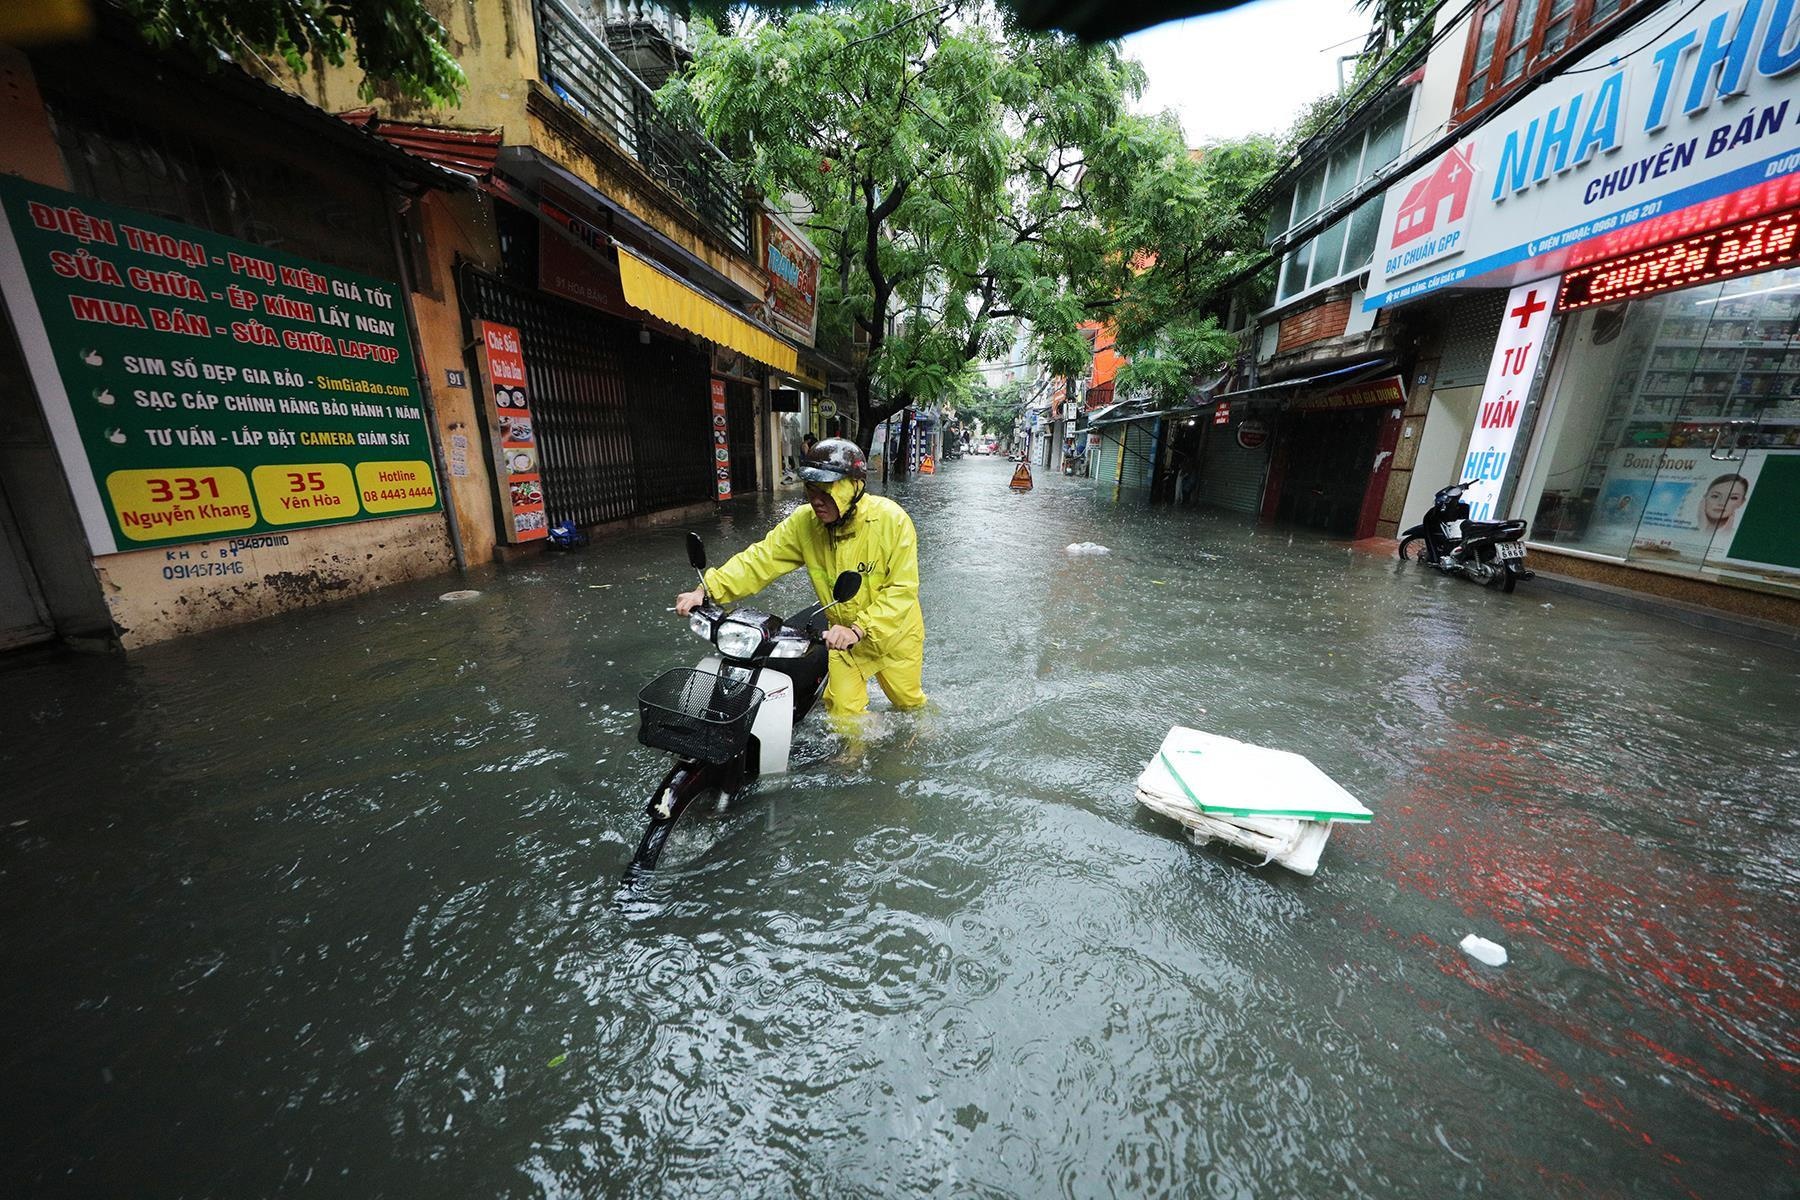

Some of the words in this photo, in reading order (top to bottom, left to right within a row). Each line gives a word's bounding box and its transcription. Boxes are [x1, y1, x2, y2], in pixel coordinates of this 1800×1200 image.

[1583, 137, 1699, 205] CHUYÊN
[1705, 99, 1790, 160] BÁN
[1640, 200, 1663, 219] 201
[28, 200, 118, 245] ĐIỆN
[119, 223, 208, 268] THOẠI
[227, 252, 276, 286] PHỤ
[279, 265, 329, 295] KIỆN
[332, 281, 362, 303] GIÁ
[364, 287, 393, 309] TỐT
[1386, 254, 1403, 273] ĐẠT
[1403, 237, 1437, 266] CHUẨN
[1438, 230, 1461, 252] GPP
[1589, 243, 1710, 295] CHUYÊN
[1717, 223, 1798, 266] BÁN
[49, 248, 125, 287] SỬA
[127, 267, 208, 303] CHỮA
[227, 284, 258, 311] ÉP
[262, 293, 316, 323] KÍNH
[319, 304, 350, 328] LẤY
[355, 314, 395, 337] NGAY
[68, 294, 149, 329] MUA
[149, 308, 212, 338] BÁN
[231, 318, 281, 348] SỬA
[282, 330, 337, 355] CHỮA
[339, 338, 399, 364] LAPTOP
[1501, 342, 1532, 377] TƯ
[123, 356, 167, 376] SIM
[171, 356, 198, 378] SỐ
[202, 363, 237, 384] ĐẸP
[242, 368, 271, 385] GIA
[273, 368, 304, 387] BẢO
[317, 375, 410, 396] SimGiaBao.com
[449, 371, 461, 386] 91
[133, 389, 177, 411] SẠC
[181, 390, 219, 410] CÁP
[224, 393, 276, 413] CHÍNH
[279, 397, 320, 415] HÃNG
[322, 398, 349, 416] BẢO
[351, 401, 384, 418] HÀNH
[385, 406, 393, 418] 1
[396, 406, 420, 420] NĂM
[1481, 390, 1520, 429] VẤN
[144, 427, 173, 446] TƯ
[175, 424, 217, 446] VẤN
[231, 425, 263, 446] LẮP
[267, 428, 296, 449] ĐẶT
[300, 431, 356, 446] CAMERA
[357, 430, 388, 446] GIÁM
[391, 430, 411, 446] SÁT
[379, 469, 416, 483] Hotline
[1464, 446, 1506, 485] HIỆU
[1623, 453, 1654, 469] Boni
[1658, 454, 1698, 471] Snow
[147, 477, 220, 503] 331
[287, 471, 326, 493] 35
[363, 490, 378, 503] 08
[381, 488, 407, 501] 4443
[408, 486, 434, 499] 4444
[122, 504, 195, 529] Nguyễn
[198, 503, 252, 519] Khang
[280, 496, 310, 510] Yên
[315, 493, 341, 507] Hòa
